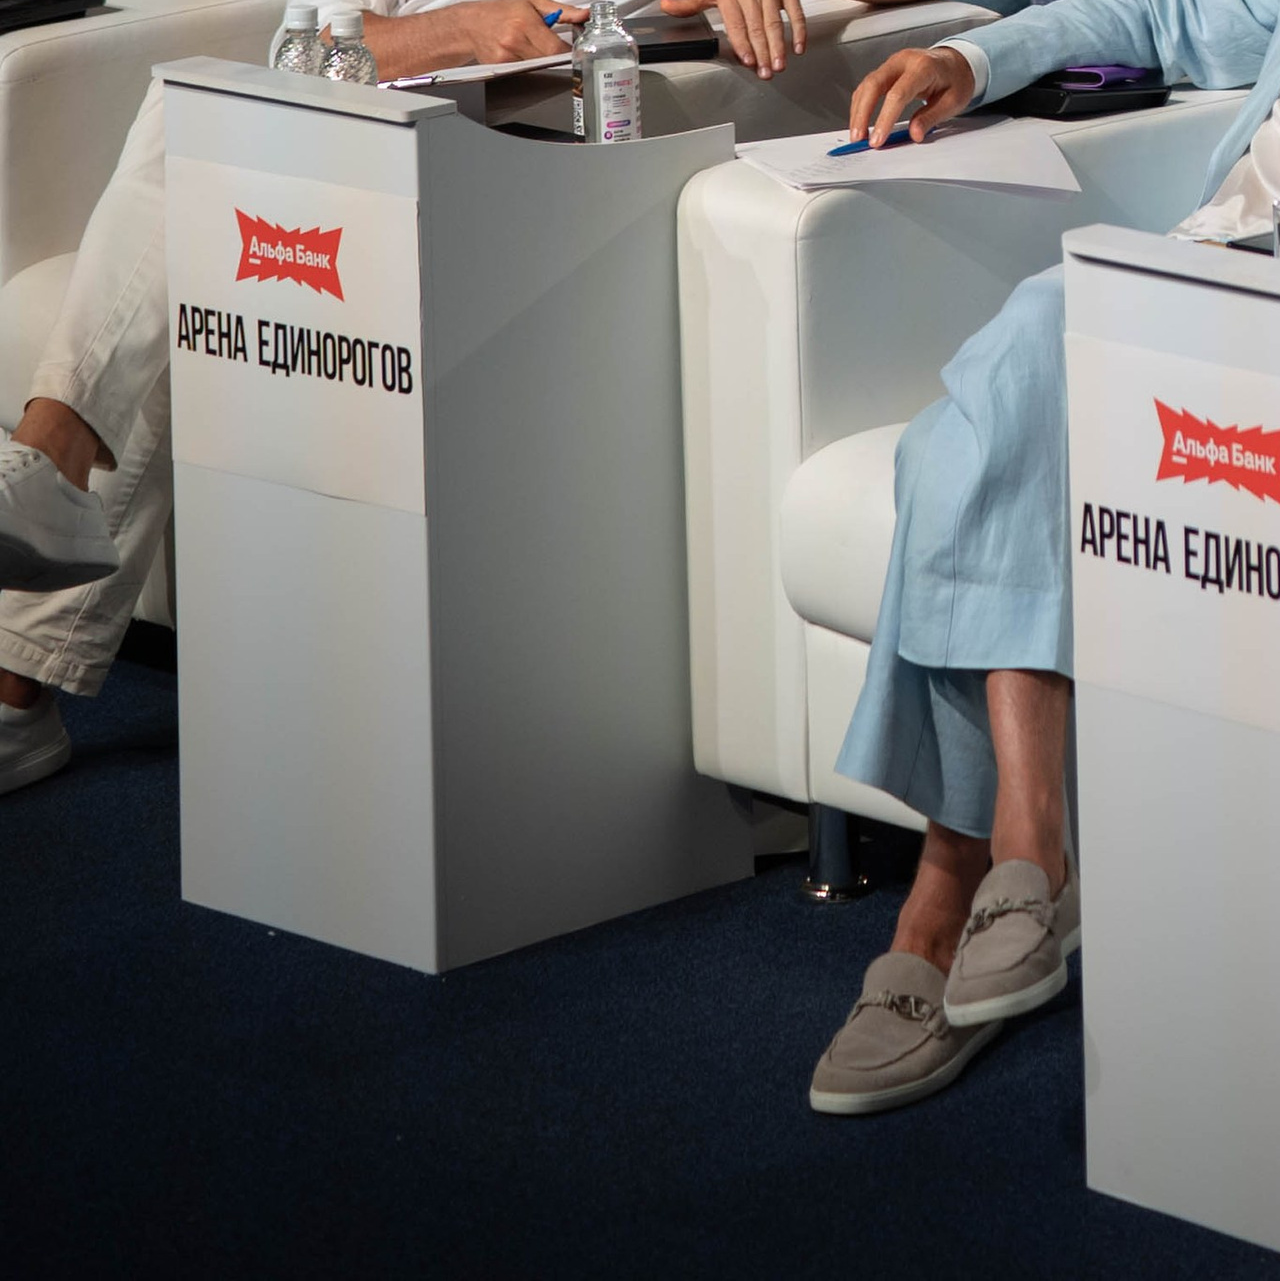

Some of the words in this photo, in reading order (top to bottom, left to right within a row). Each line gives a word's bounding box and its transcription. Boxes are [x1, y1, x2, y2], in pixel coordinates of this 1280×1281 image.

[248, 235, 294, 266] Альфа
[295, 243, 331, 270] Банк
[177, 303, 249, 364] АРЕНА
[257, 319, 413, 396] ЕДИНОРОГОВ
[1172, 429, 1230, 468] Альфа
[1231, 442, 1277, 475] Банк
[1080, 501, 1172, 574] АРЕНА
